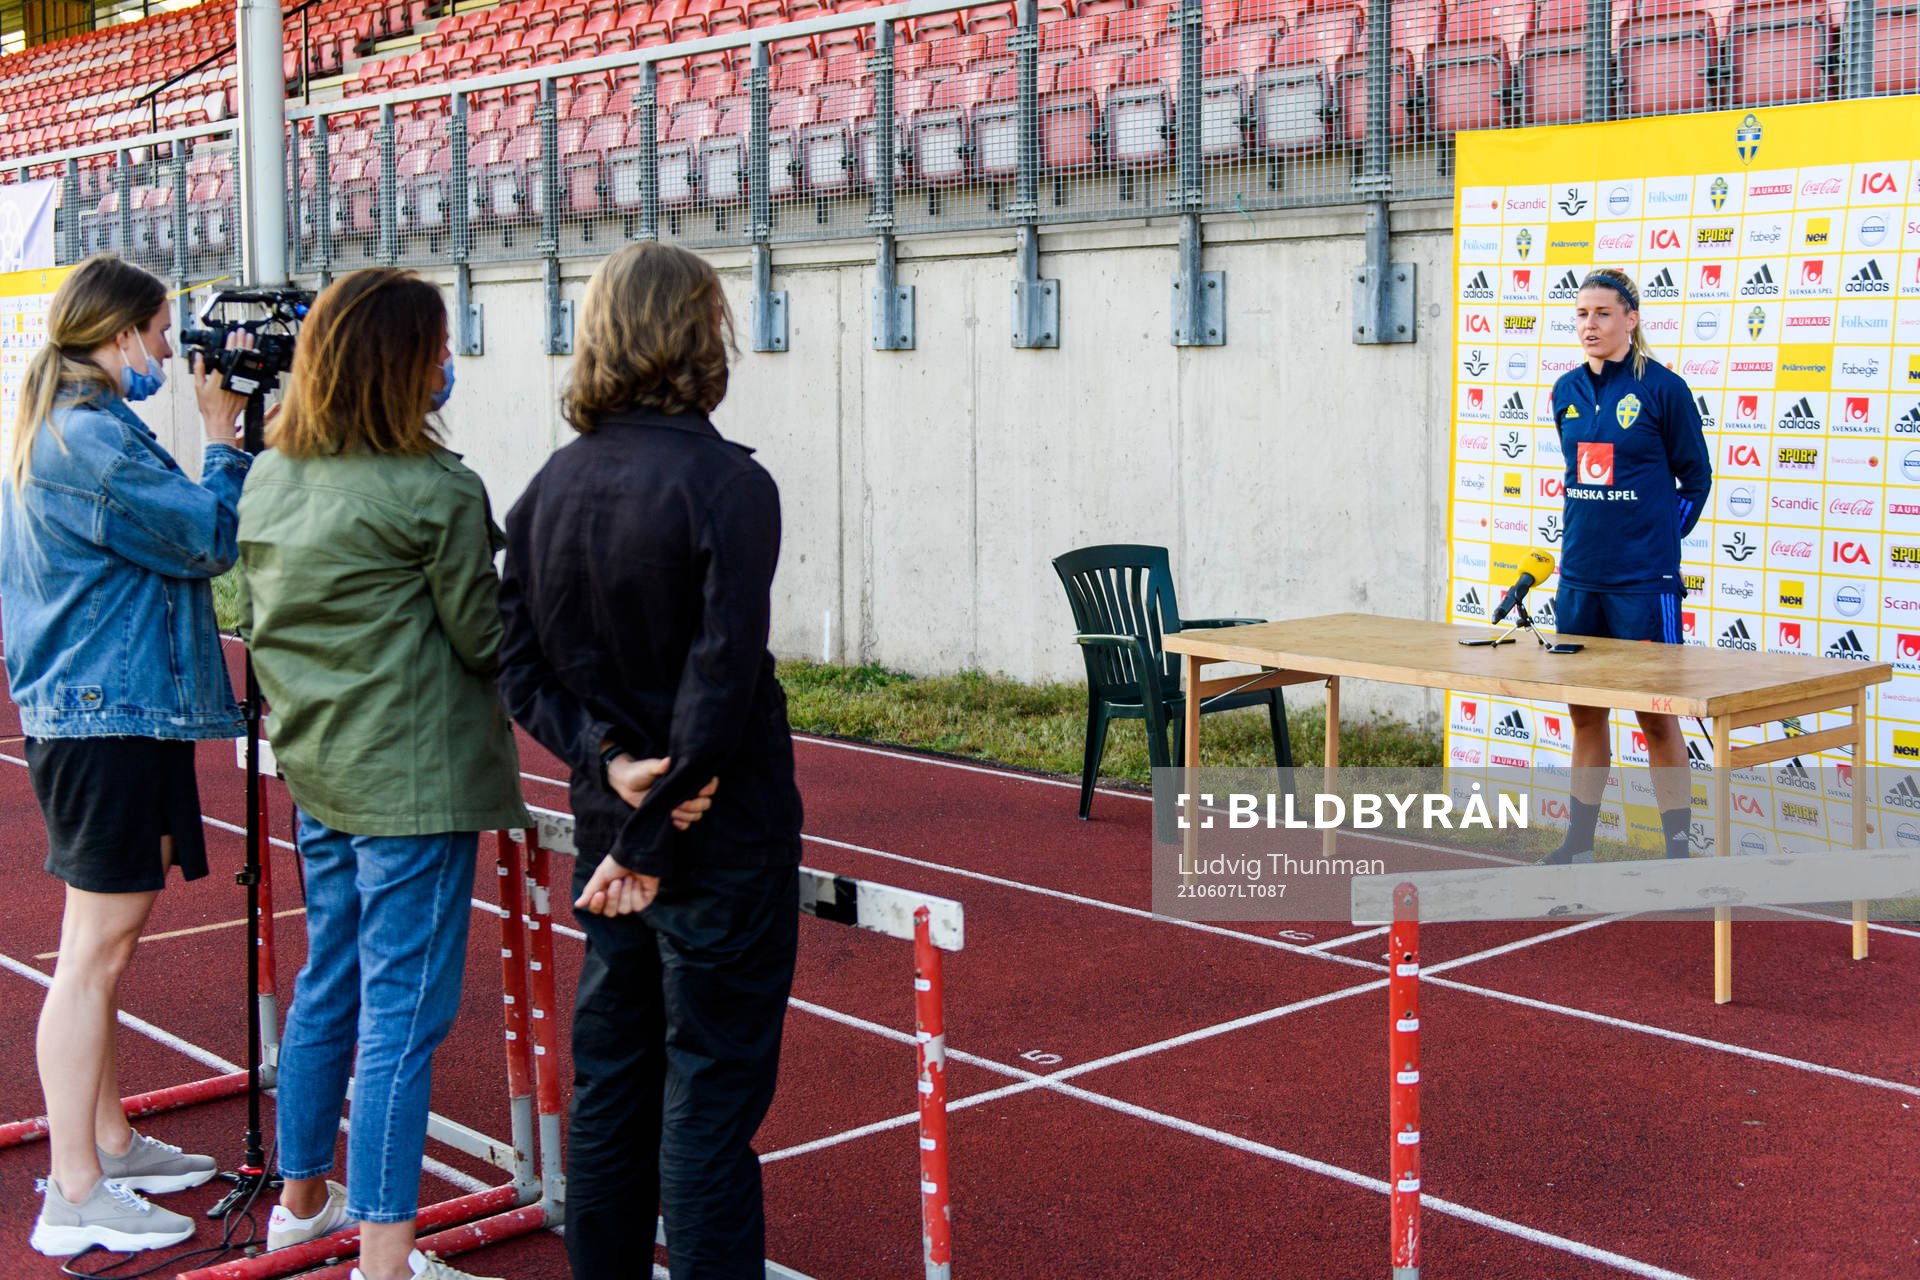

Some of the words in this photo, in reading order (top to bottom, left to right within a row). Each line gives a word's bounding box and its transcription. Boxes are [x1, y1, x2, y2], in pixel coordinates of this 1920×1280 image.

[1861, 173, 1897, 194] ICA
[1568, 189, 1578, 200] SJ
[1749, 184, 1792, 196] BAUHAUS
[1648, 191, 1688, 204] Folksam
[1507, 198, 1546, 210] Scandic
[1651, 229, 1680, 249] ICA
[1698, 228, 1733, 242] SPORT
[1750, 231, 1781, 243] Fabege
[1741, 285, 1778, 296] adidas
[1845, 280, 1890, 292] adidas
[1464, 290, 1493, 299] adidas
[1644, 287, 1679, 298] adidas
[1466, 315, 1490, 333] ICA
[1504, 316, 1536, 329] SPORT
[1786, 317, 1830, 326] BAUHAUS
[1841, 316, 1887, 328] Folksam
[1472, 351, 1480, 362] SJ
[1731, 362, 1773, 372] BAUHAUS
[1842, 363, 1878, 377] Fabege
[1500, 409, 1528, 420] adidas
[1779, 418, 1820, 430] adidas
[1509, 432, 1518, 444] SJ
[1728, 445, 1760, 466] ICA
[1779, 448, 1817, 464] SPORT
[1540, 478, 1564, 496] ICA
[1567, 488, 1604, 500] SVENSKA
[1608, 490, 1638, 500] SPEL
[1771, 497, 1818, 510] Scandic
[1494, 519, 1528, 531] Scandic
[1548, 516, 1557, 527] SJ
[1734, 532, 1746, 544] SJ
[1833, 542, 1871, 564] ICA
[1722, 584, 1753, 599] Fabege
[1456, 604, 1485, 615] adidas
[1718, 637, 1757, 651] adidas
[1825, 651, 1869, 661] adidas
[1495, 727, 1529, 739] adidas
[1491, 755, 1529, 768] BAUHAUS
[1752, 775, 1766, 783] SPEL
[1777, 775, 1816, 790] adidas
[1542, 800, 1570, 819] ICA
[1732, 793, 1764, 817] ICA
[1782, 802, 1818, 821] SPORT
